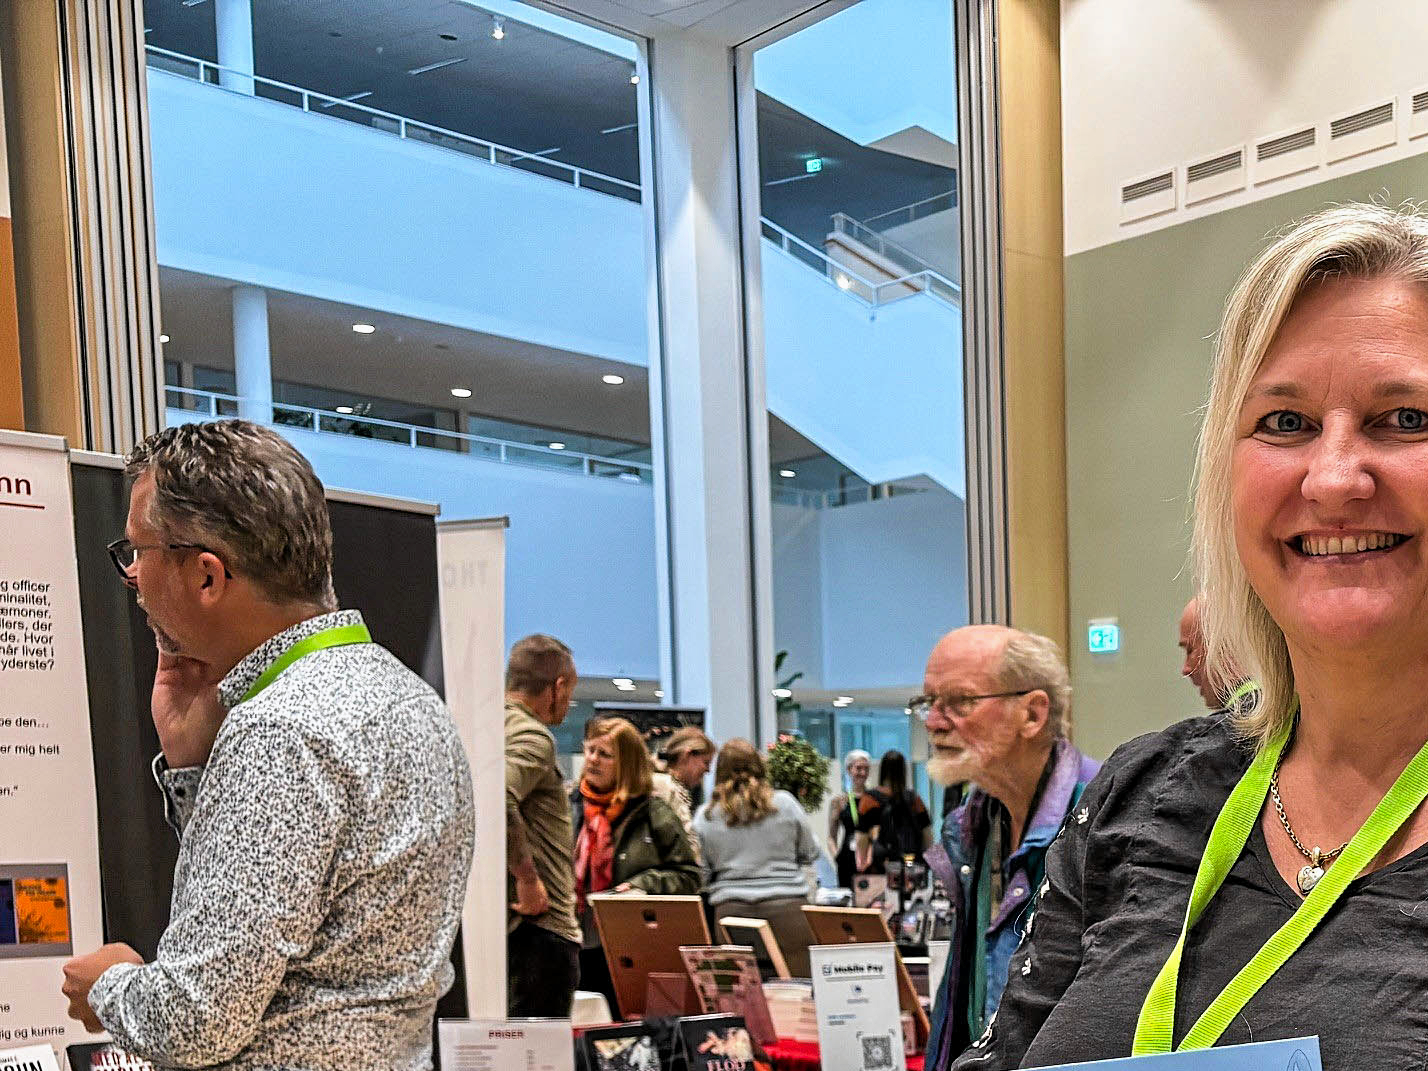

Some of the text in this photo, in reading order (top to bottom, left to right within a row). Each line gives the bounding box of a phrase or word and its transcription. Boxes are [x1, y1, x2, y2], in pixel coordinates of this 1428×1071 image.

[12, 580, 50, 592] officer
[32, 620, 53, 632] der
[24, 633, 53, 645] Hvor
[22, 645, 47, 657] livet
[1, 658, 54, 671] yderste?
[15, 745, 35, 757] mig
[39, 744, 60, 755] helt
[14, 1029, 28, 1040] og
[31, 1026, 65, 1038] kunne
[488, 1030, 525, 1039] PRISER
